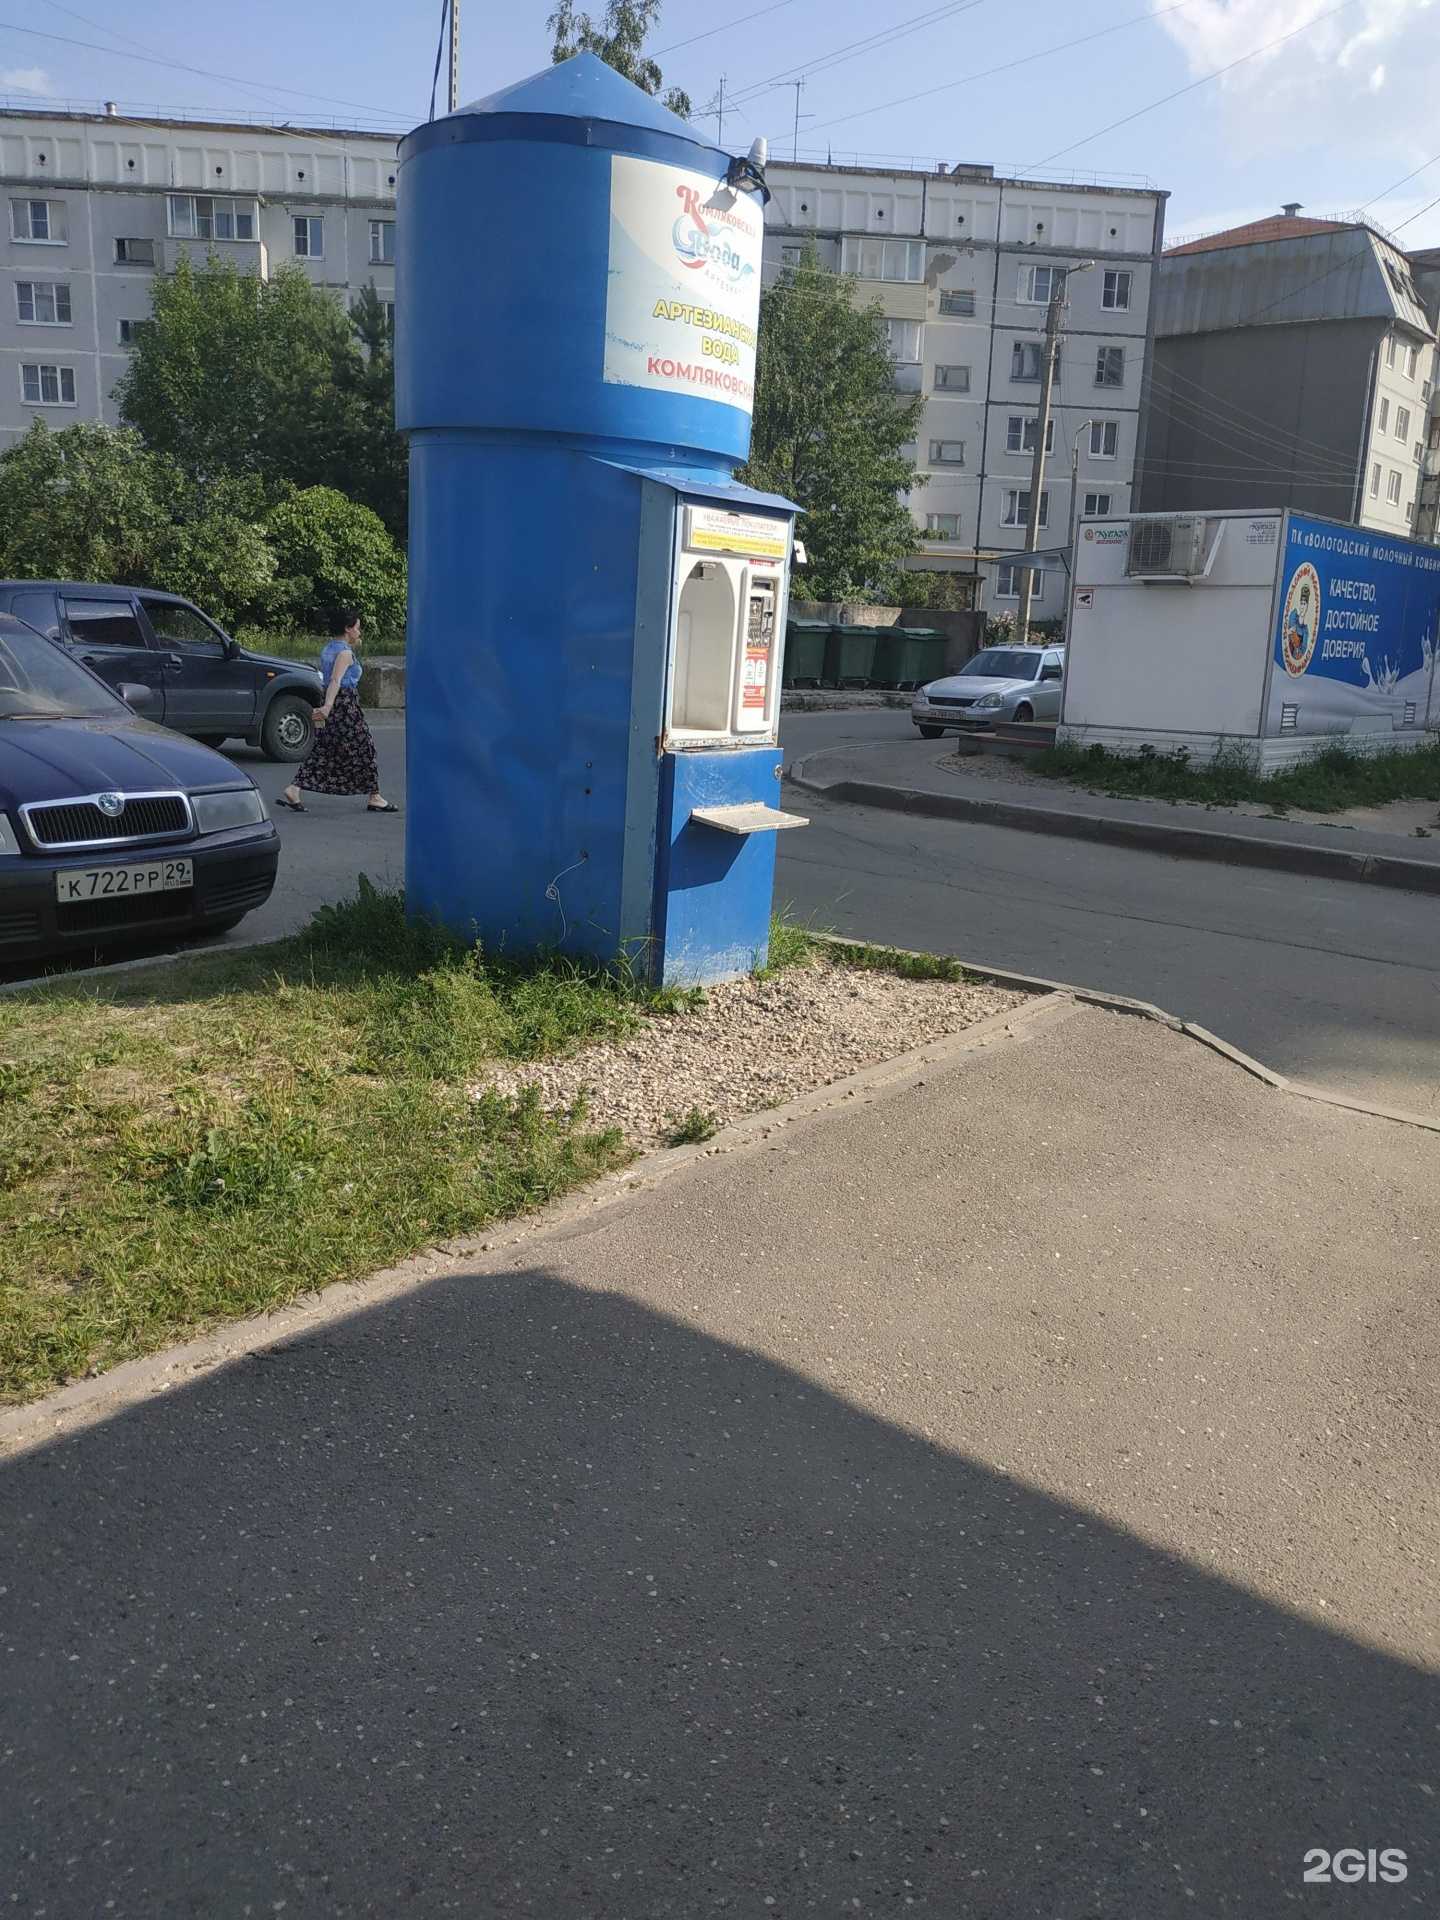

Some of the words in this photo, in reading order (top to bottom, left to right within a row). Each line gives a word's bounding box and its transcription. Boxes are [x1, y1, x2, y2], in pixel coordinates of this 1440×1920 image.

[701, 336, 740, 366] ВОДА
[1291, 528, 1303, 546] ПК
[1304, 533, 1369, 557] «ВОЛОГОДСКИЙ
[1373, 547, 1413, 568] МОЛОЧНЫЙ
[1329, 578, 1377, 603] КАЧЕСТВО,
[1324, 609, 1380, 632] ДОСТОЙНОЕ
[1321, 639, 1366, 660] ДОВЕРИЯ
